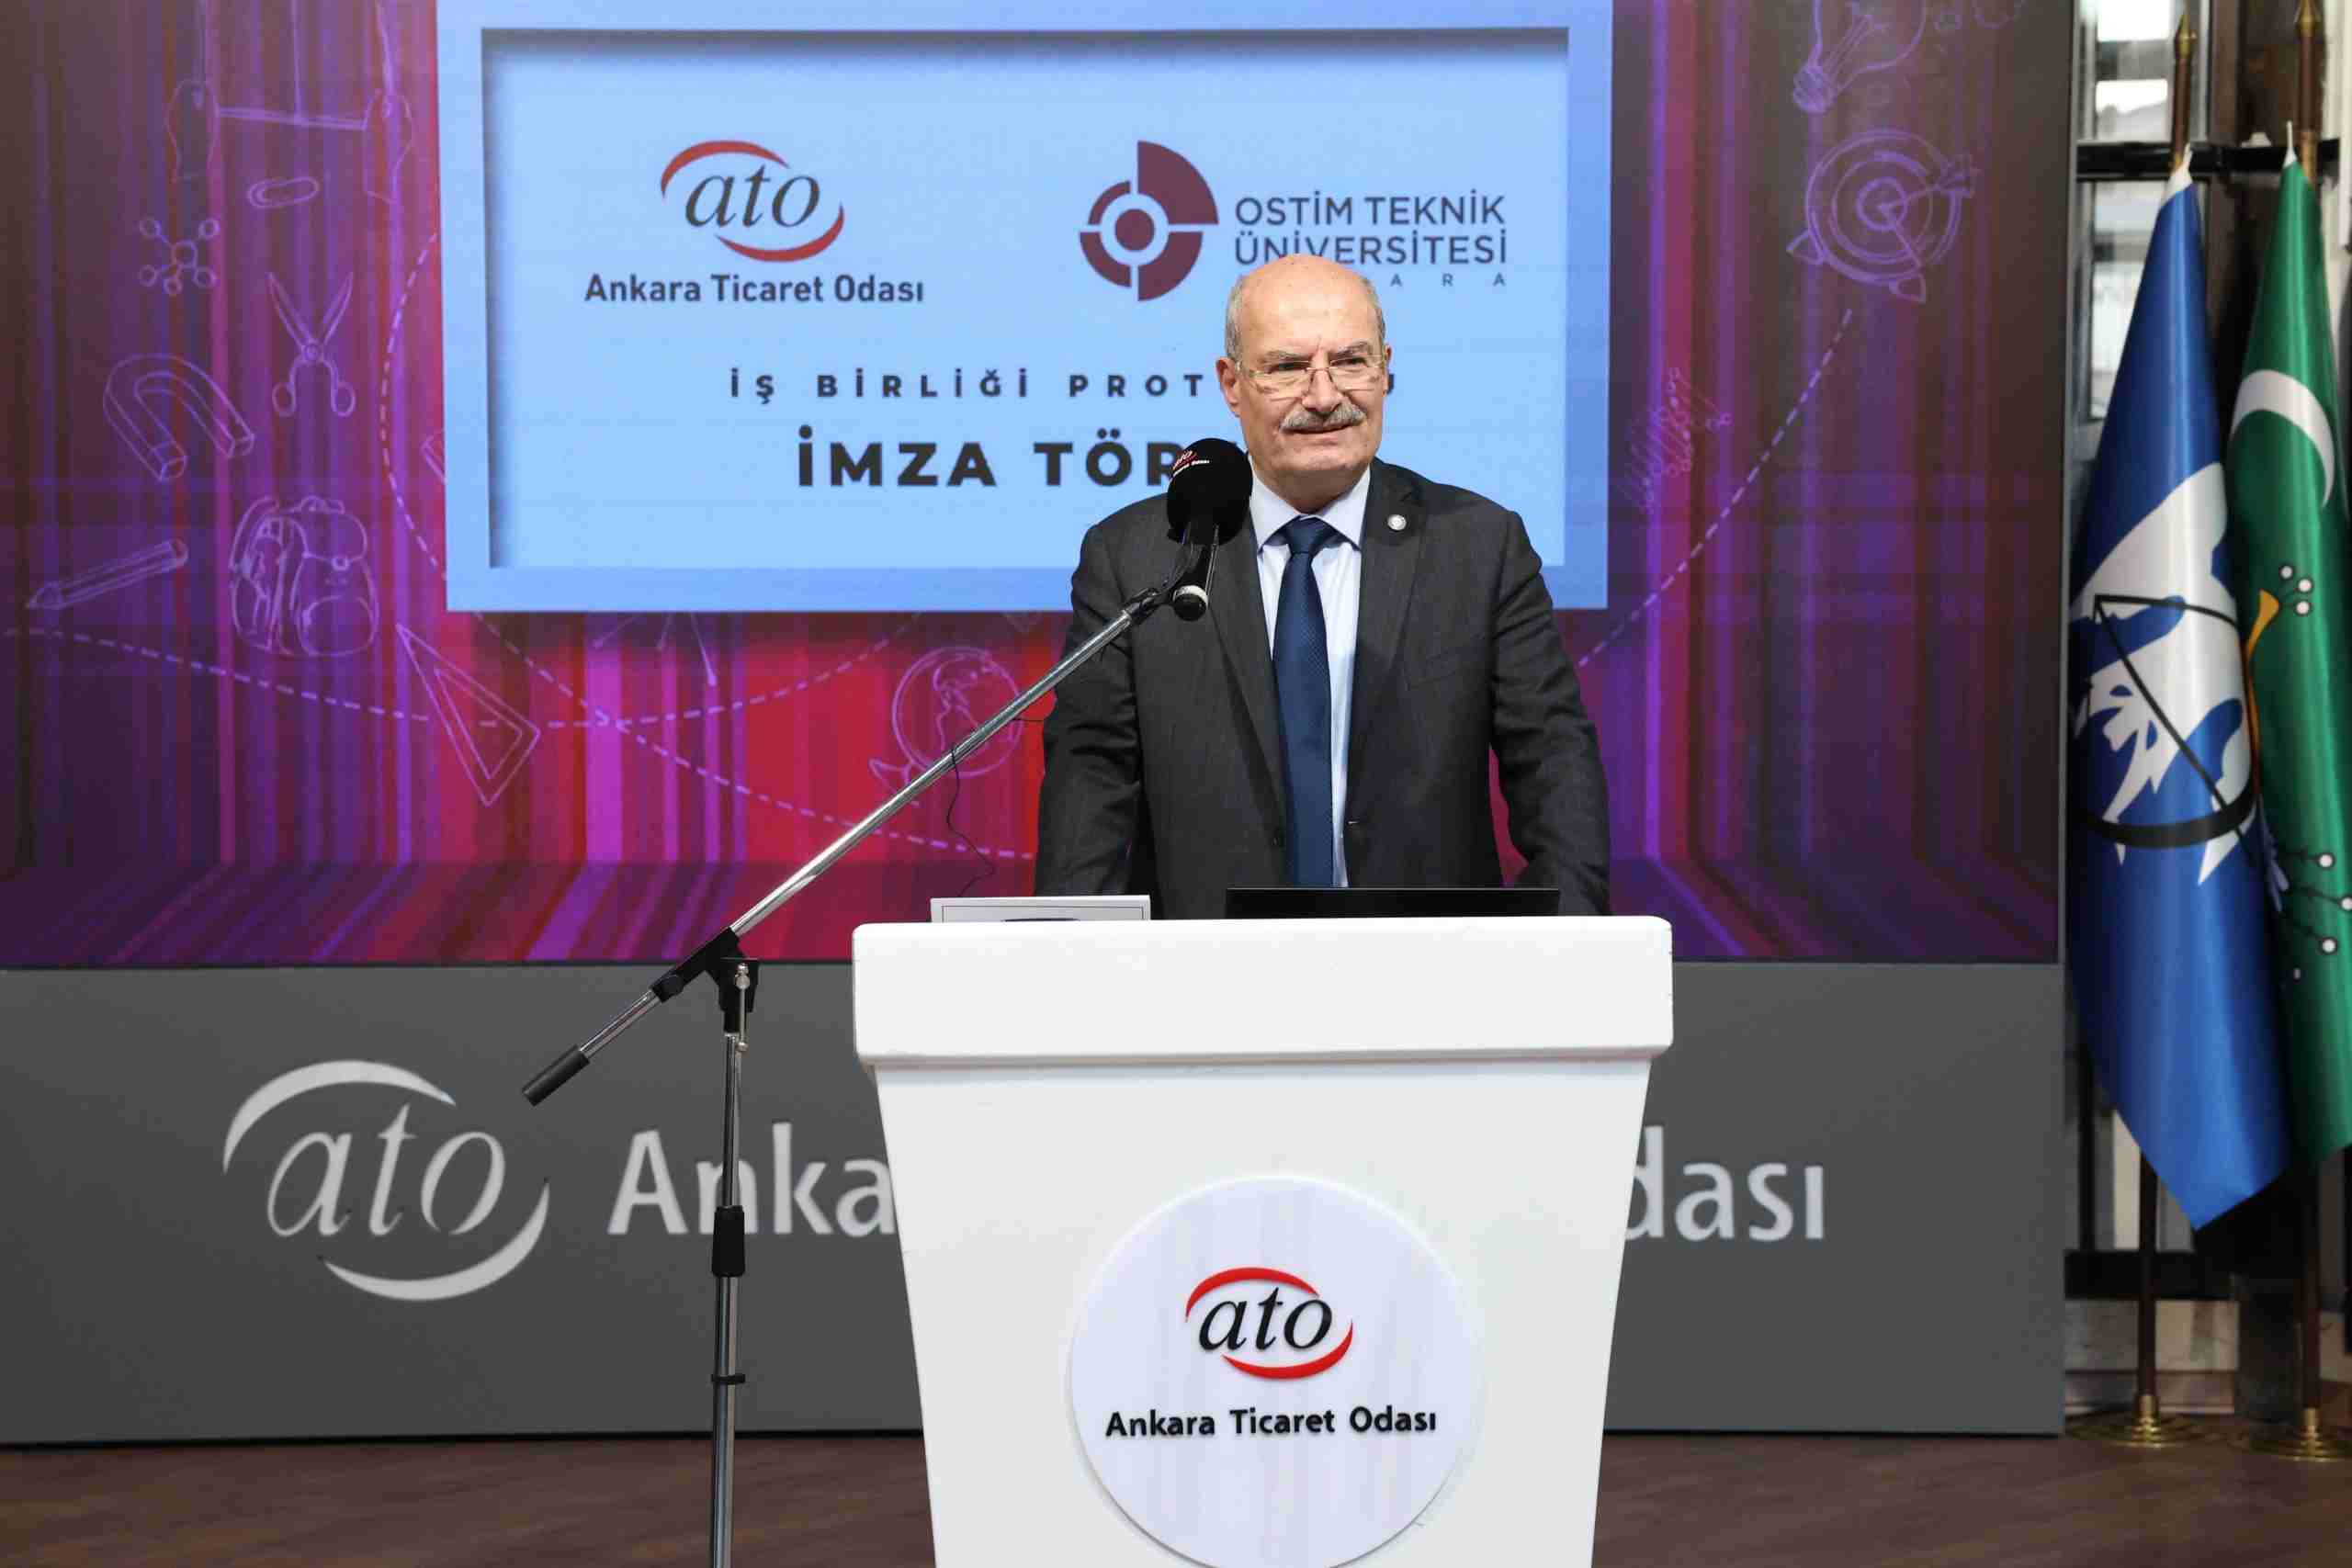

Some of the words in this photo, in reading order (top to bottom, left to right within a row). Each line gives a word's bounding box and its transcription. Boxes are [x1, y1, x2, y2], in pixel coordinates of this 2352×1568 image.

[684, 164, 820, 228] ato
[1235, 189, 1353, 226] OSTİM
[1364, 188, 1505, 226] TEKNİK
[1235, 229, 1507, 265] ÜNİVERSİTESİ
[584, 274, 702, 303] Ankara
[710, 274, 824, 303] Ticaret
[834, 274, 924, 303] Odası
[731, 367, 775, 405] İŞ
[818, 367, 1027, 398] BİRLİĞİ
[799, 425, 997, 487] İMZA
[1034, 428, 1185, 488] TÖR
[266, 1104, 506, 1237] ato
[607, 1122, 898, 1237] Anka
[1625, 1125, 1825, 1242] dası
[1198, 1286, 1333, 1351] ato
[1105, 1409, 1216, 1438] Ankara
[1229, 1407, 1336, 1436] Ticaret
[1349, 1405, 1436, 1434] Odası
